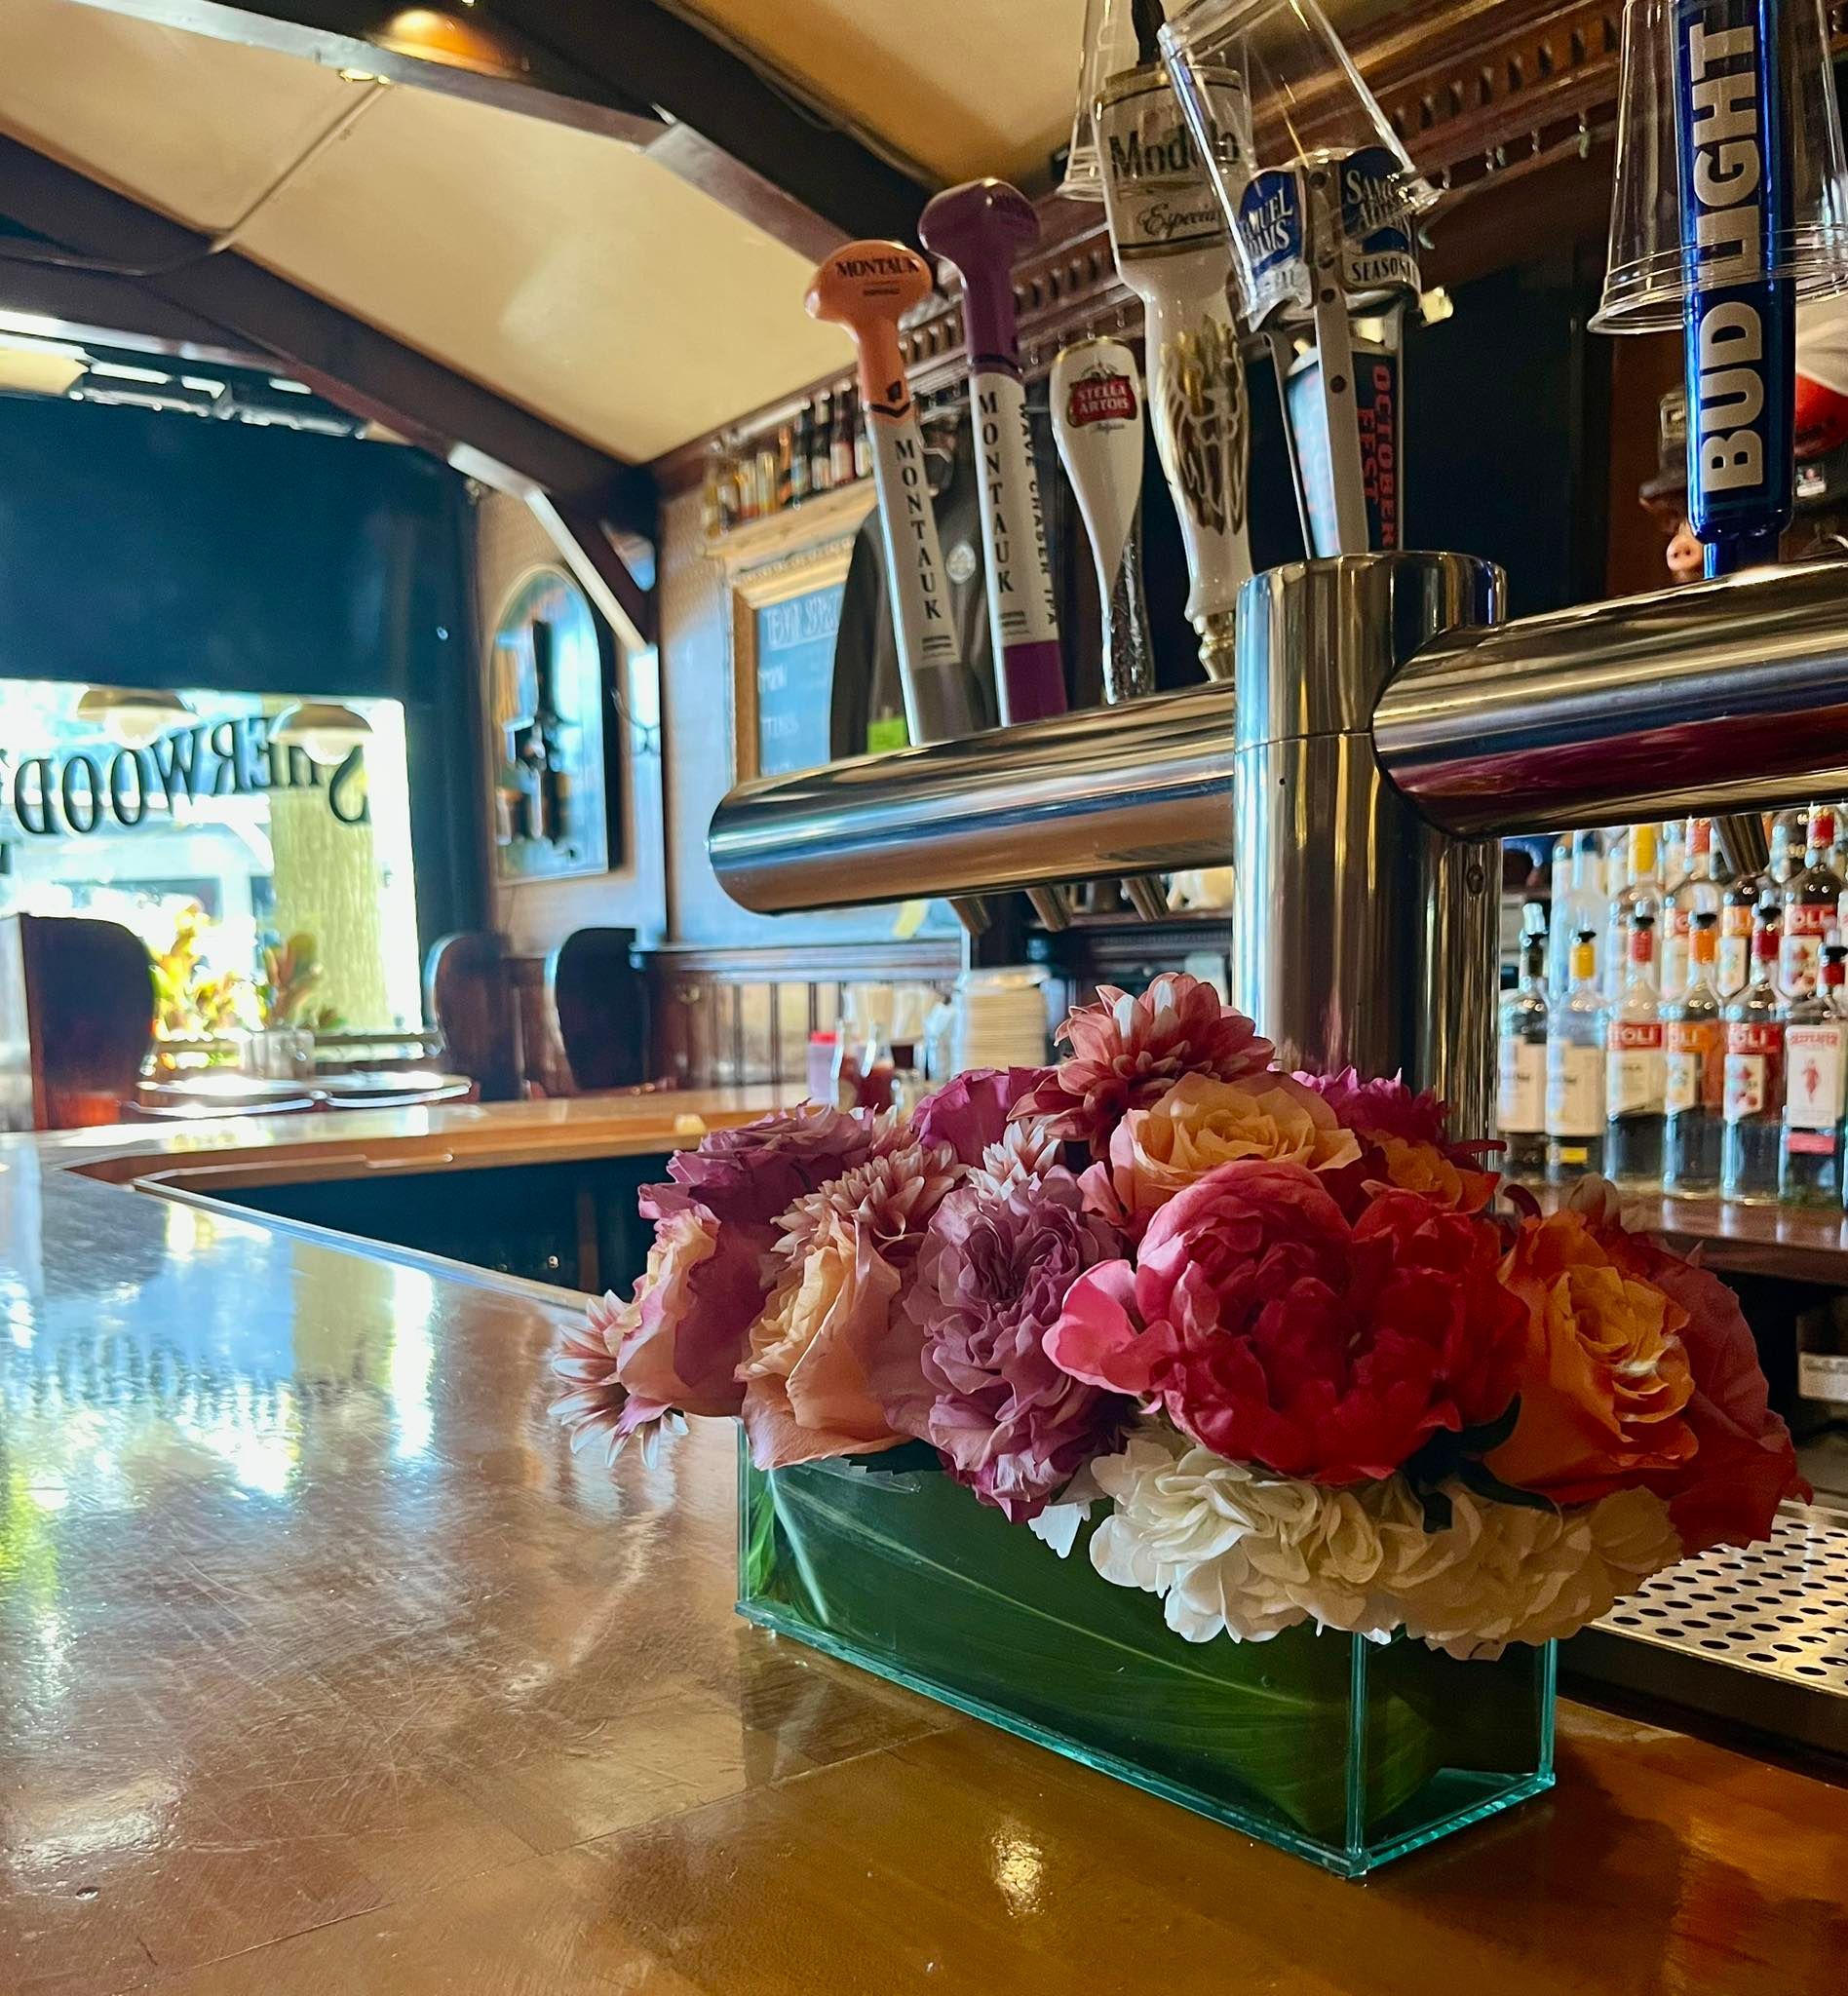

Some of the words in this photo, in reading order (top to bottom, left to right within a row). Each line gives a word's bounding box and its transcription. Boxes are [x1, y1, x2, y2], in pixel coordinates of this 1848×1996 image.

[1689, 22, 1761, 292] LIGHT
[1238, 187, 1293, 242] AMUEL
[1248, 218, 1290, 258] DAMS
[1351, 256, 1412, 282] SEASON
[1077, 380, 1128, 402] STELLA
[1079, 397, 1131, 414] ARTOIS
[1699, 300, 1764, 491] BUD
[979, 391, 1015, 594] MONTAUK
[894, 439, 943, 621] MONTAUK
